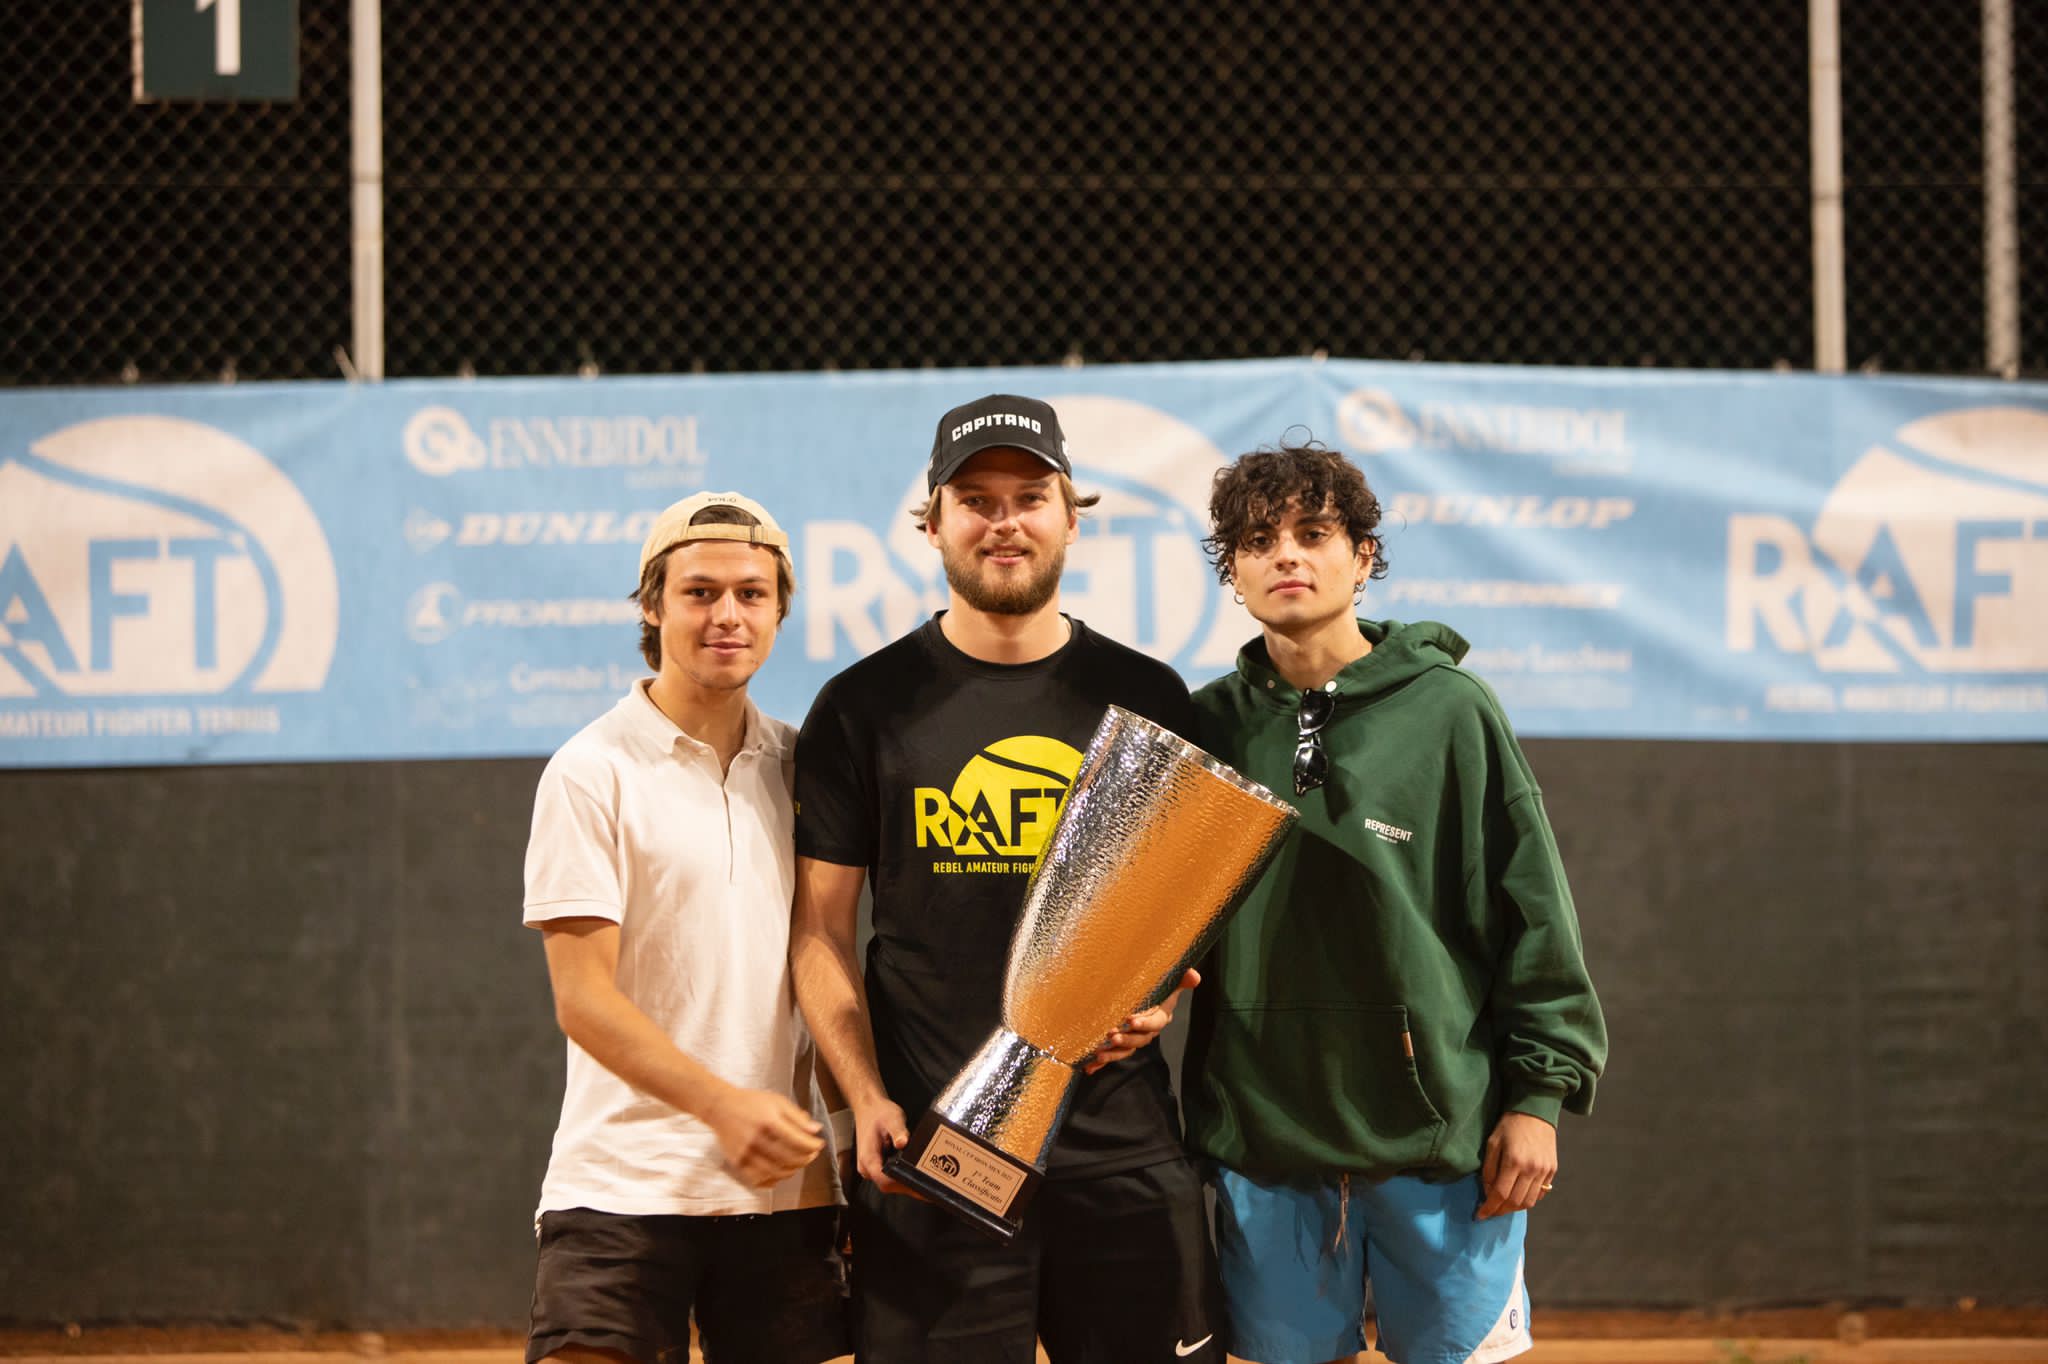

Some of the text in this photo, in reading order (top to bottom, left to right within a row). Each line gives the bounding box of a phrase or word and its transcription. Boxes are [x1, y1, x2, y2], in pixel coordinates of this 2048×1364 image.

[195, 0, 241, 75] 1
[952, 413, 1042, 442] CAPITANO
[1385, 492, 1636, 528] DUNLOP
[456, 511, 662, 546] DUNLO
[1727, 512, 2048, 652] RAF
[1364, 818, 1414, 842] REPRESENT
[933, 862, 964, 873] REBEL
[966, 862, 1010, 873] AMATEUR
[981, 1176, 1001, 1191] Team
